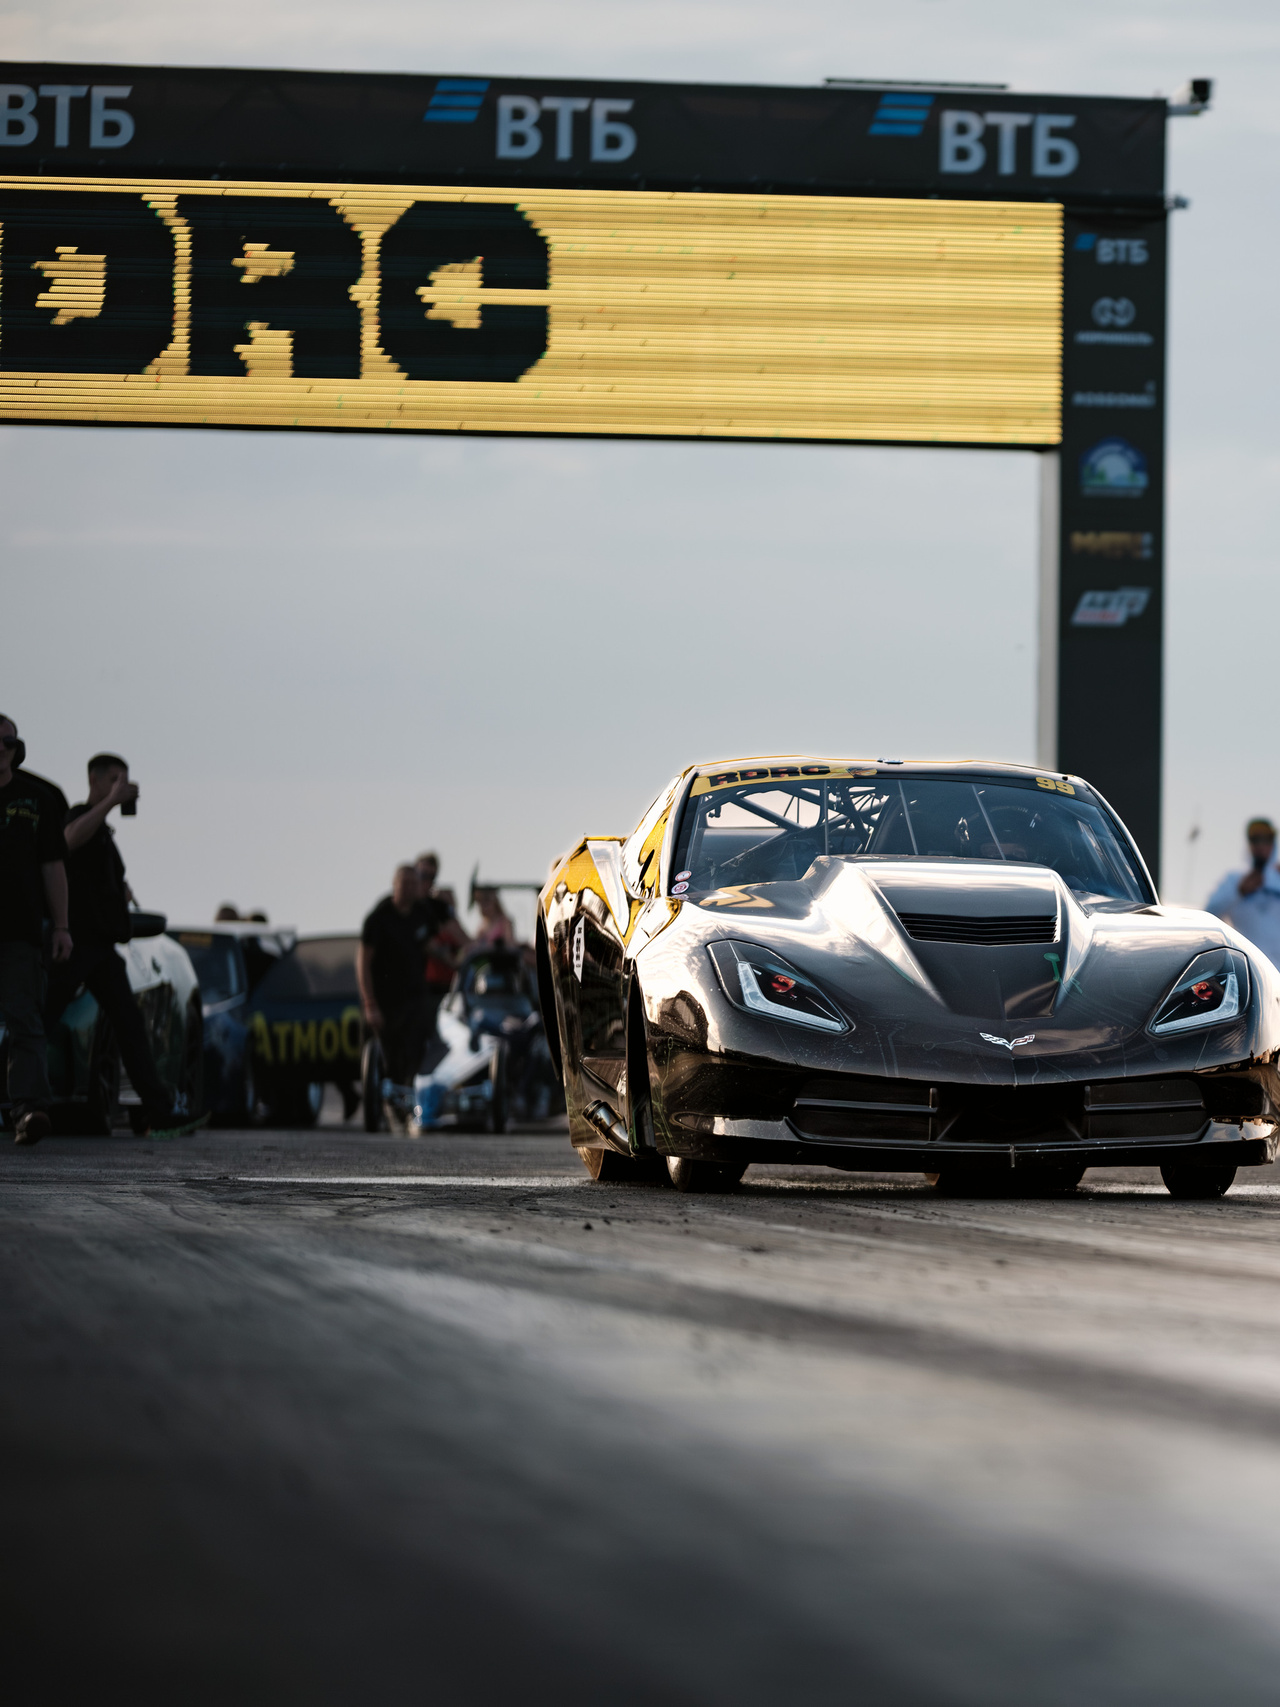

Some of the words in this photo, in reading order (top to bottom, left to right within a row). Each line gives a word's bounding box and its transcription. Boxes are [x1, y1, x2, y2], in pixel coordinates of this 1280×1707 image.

[0, 83, 136, 149] ВТБ
[496, 94, 637, 164] ВТБ
[939, 109, 1080, 178] ВТБ
[1096, 238, 1150, 265] ВТБ
[707, 765, 831, 788] RDRC
[1035, 776, 1076, 795] 99
